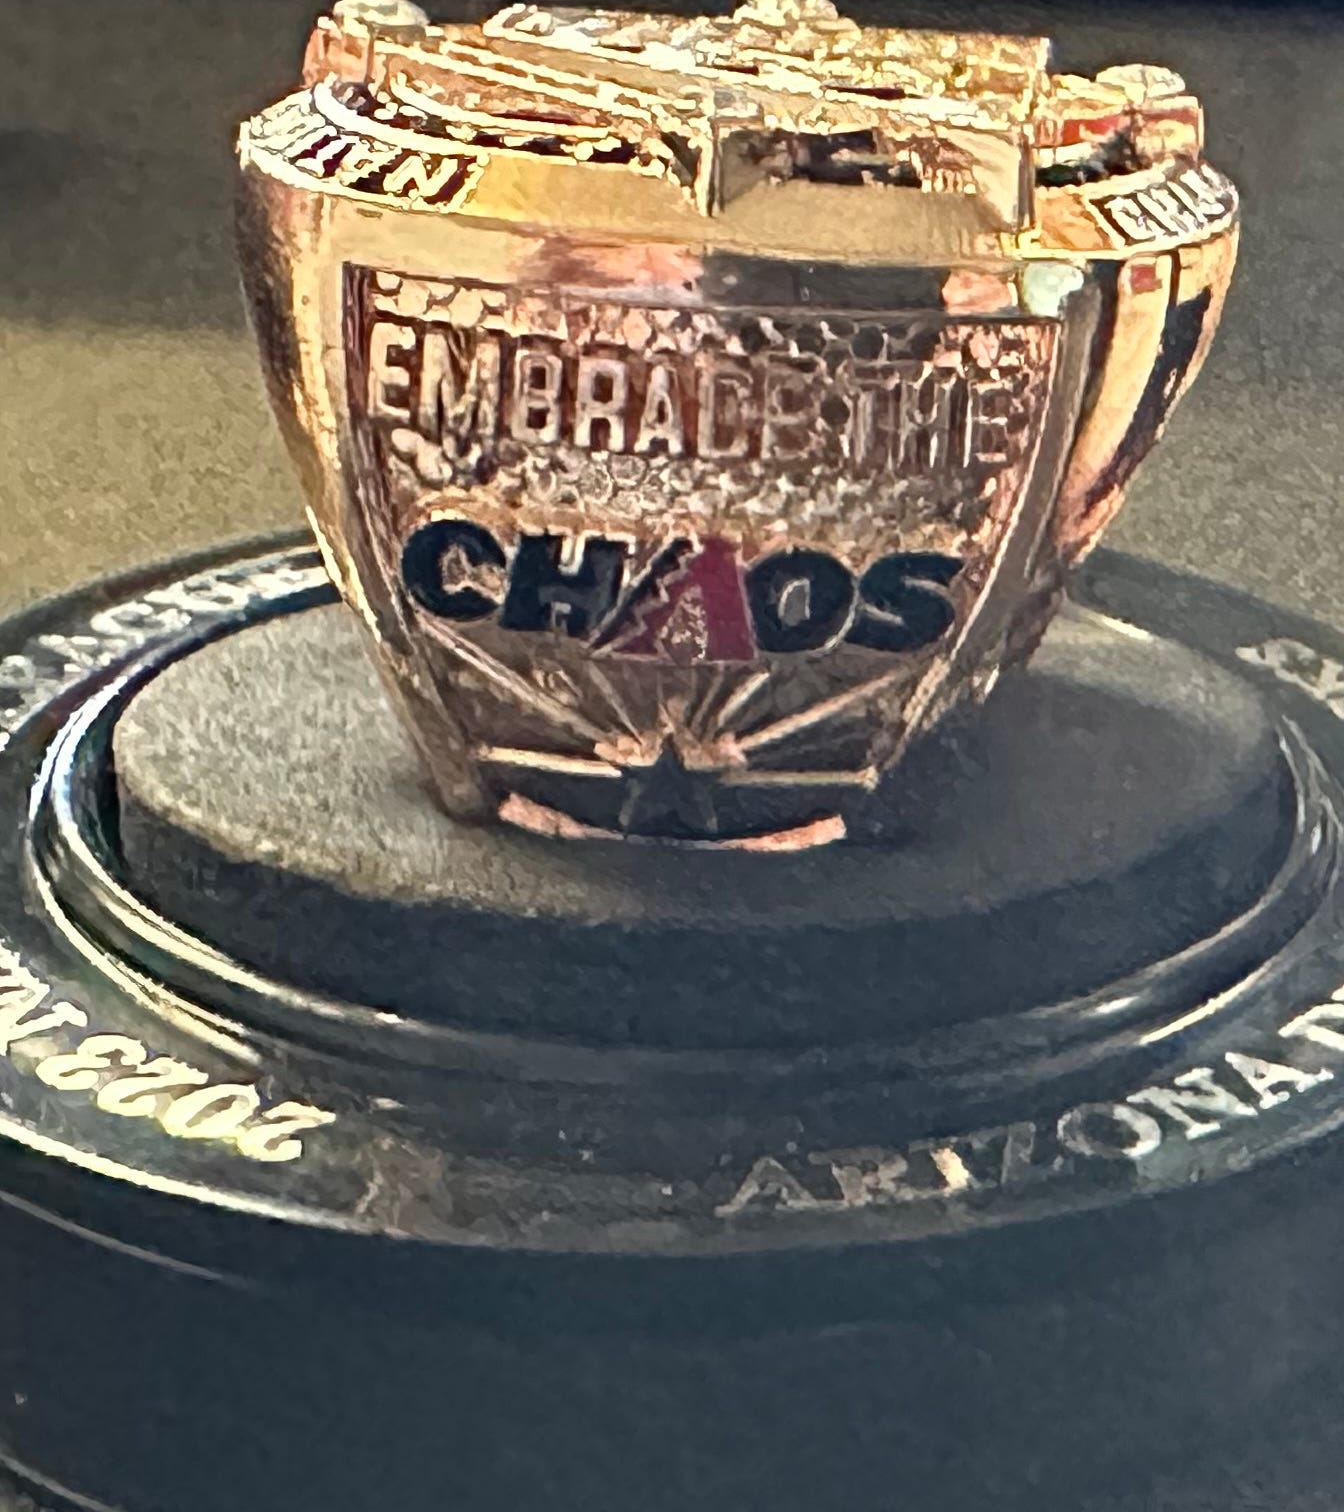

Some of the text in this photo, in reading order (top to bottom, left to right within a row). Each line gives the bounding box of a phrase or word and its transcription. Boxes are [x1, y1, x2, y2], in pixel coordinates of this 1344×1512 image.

[366, 320, 1010, 472] EMBRACE THE
[400, 516, 966, 662] CHAOS
[35, 1033, 338, 1163] 2023
